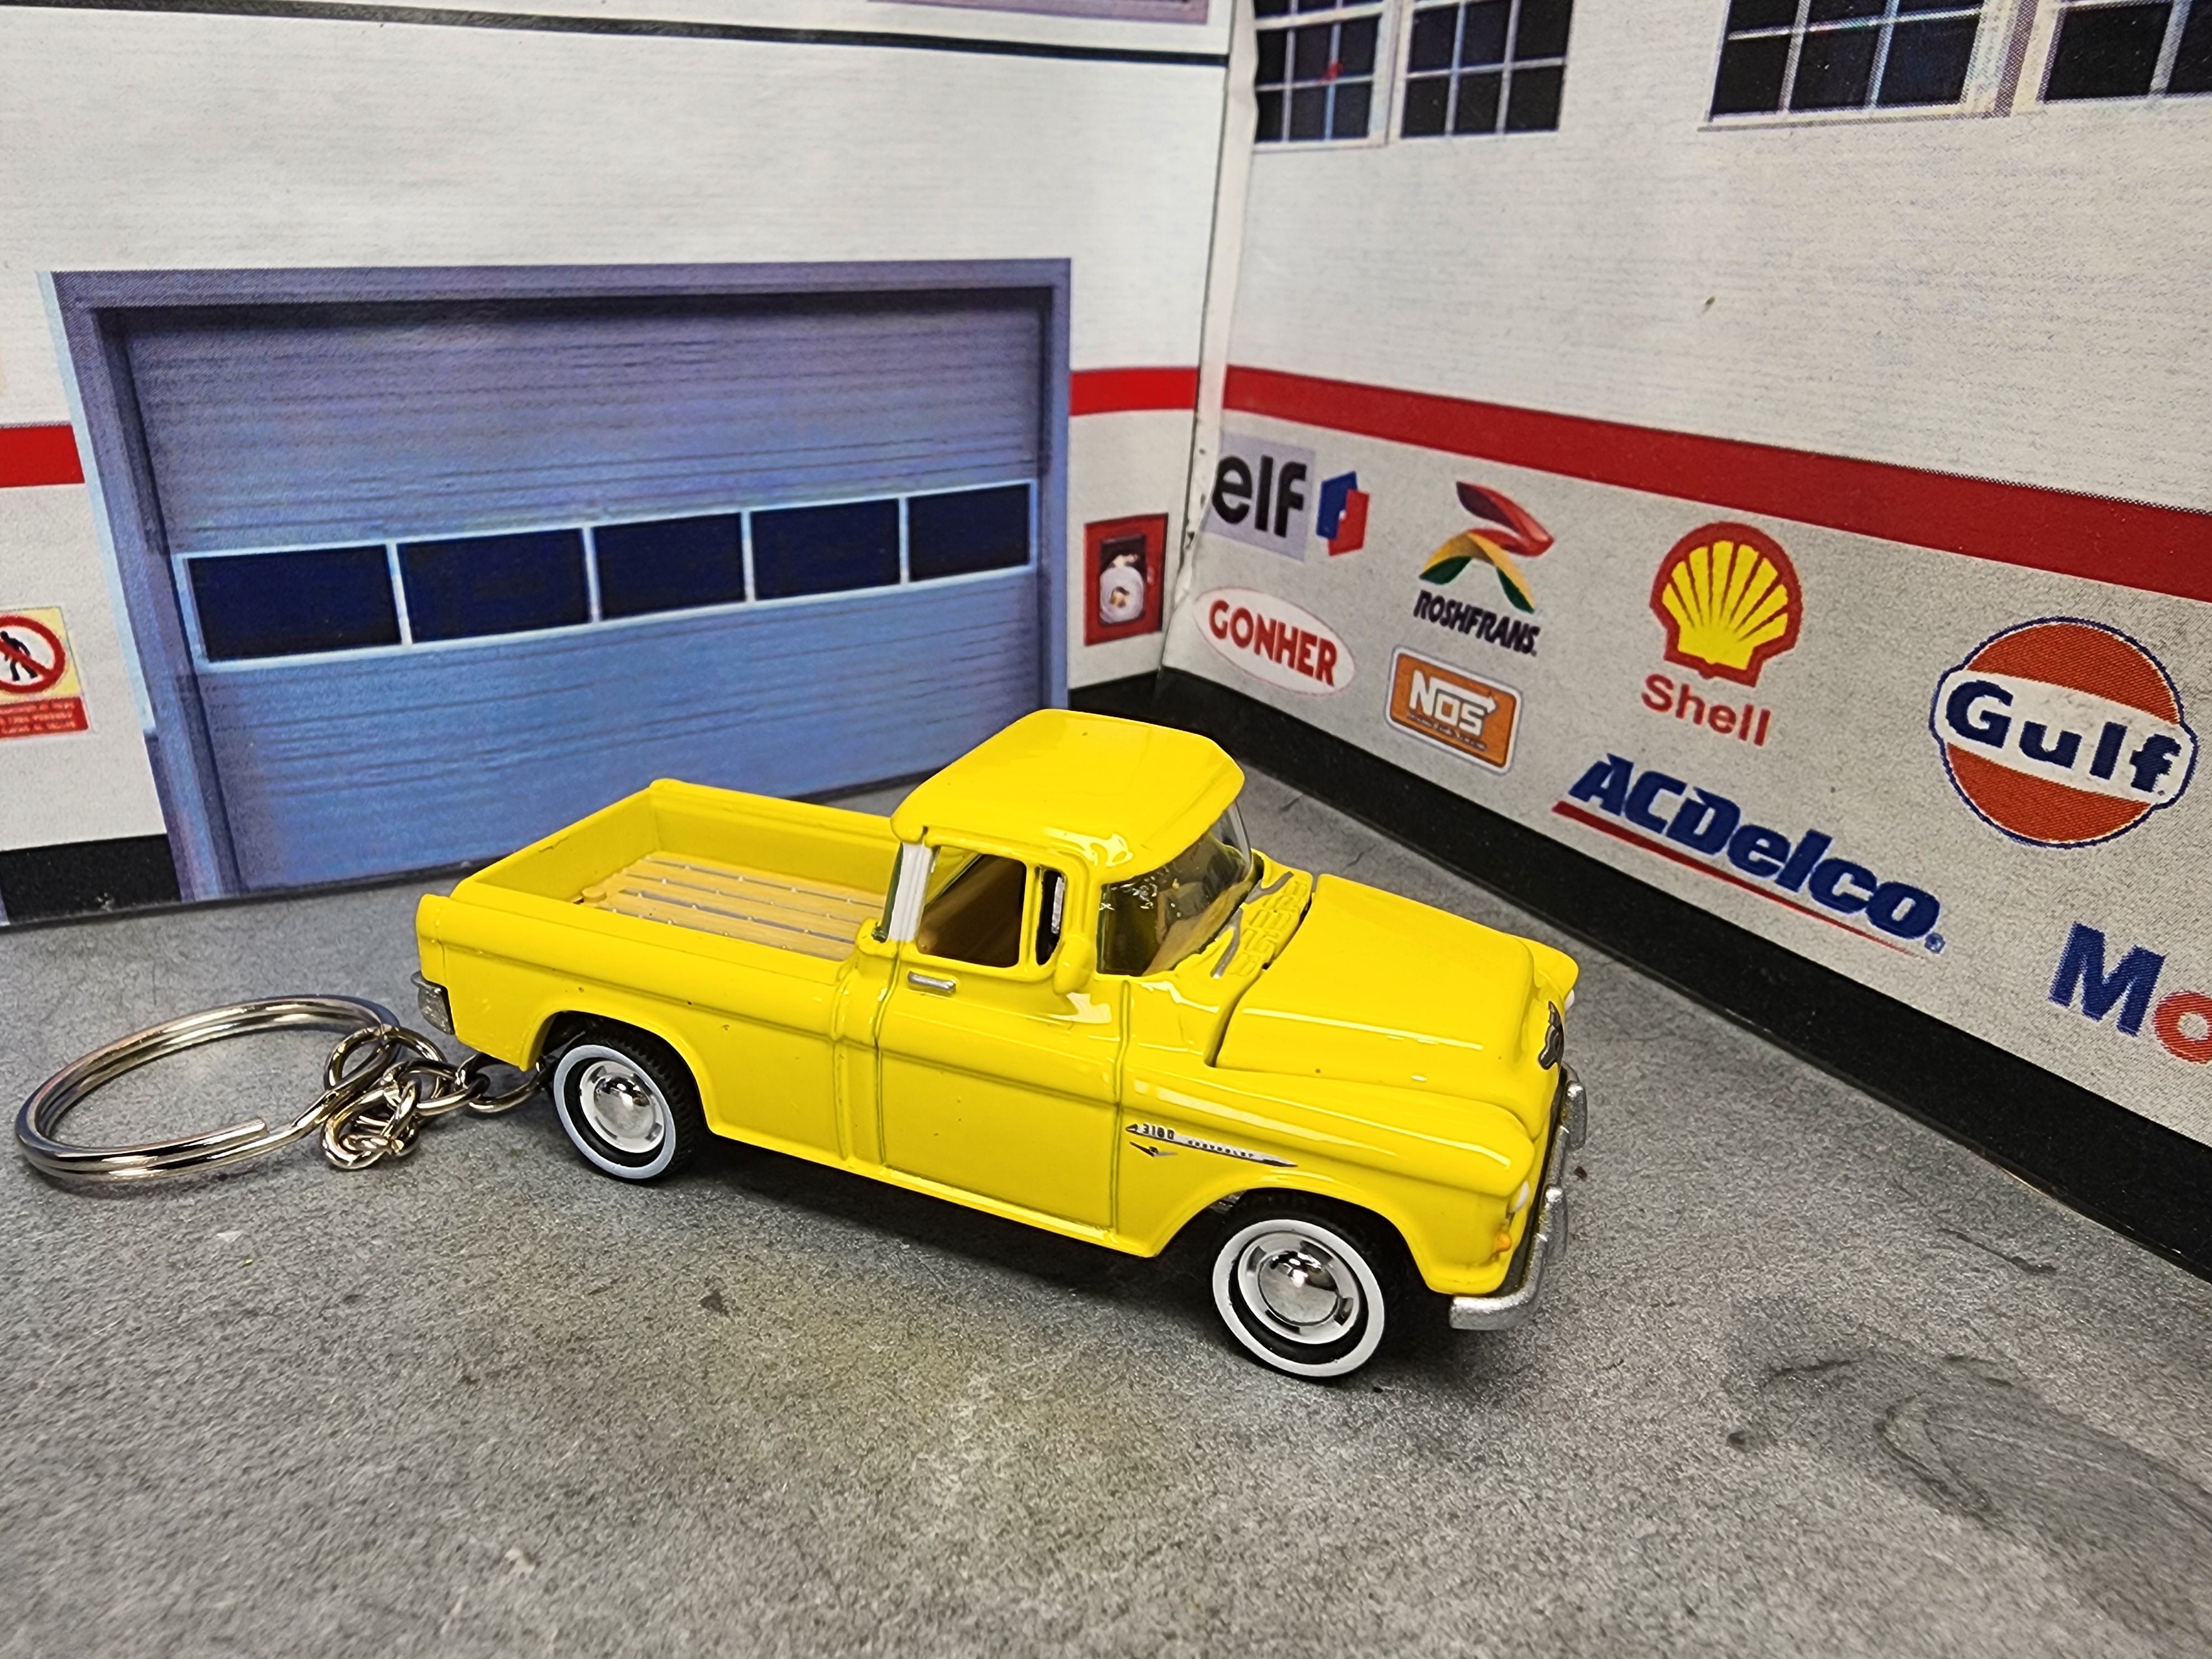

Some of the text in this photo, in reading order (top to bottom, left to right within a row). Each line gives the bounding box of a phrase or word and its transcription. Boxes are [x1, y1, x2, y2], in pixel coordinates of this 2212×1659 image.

[1212, 455, 1307, 538] elf
[1209, 599, 1338, 687] GONHER
[1413, 589, 1541, 654] ROSHFRANS
[1409, 669, 1496, 737] NOS
[1641, 674, 1771, 747] Shell
[1945, 680, 2182, 794] Gulf
[1568, 753, 1941, 940] ACDelco
